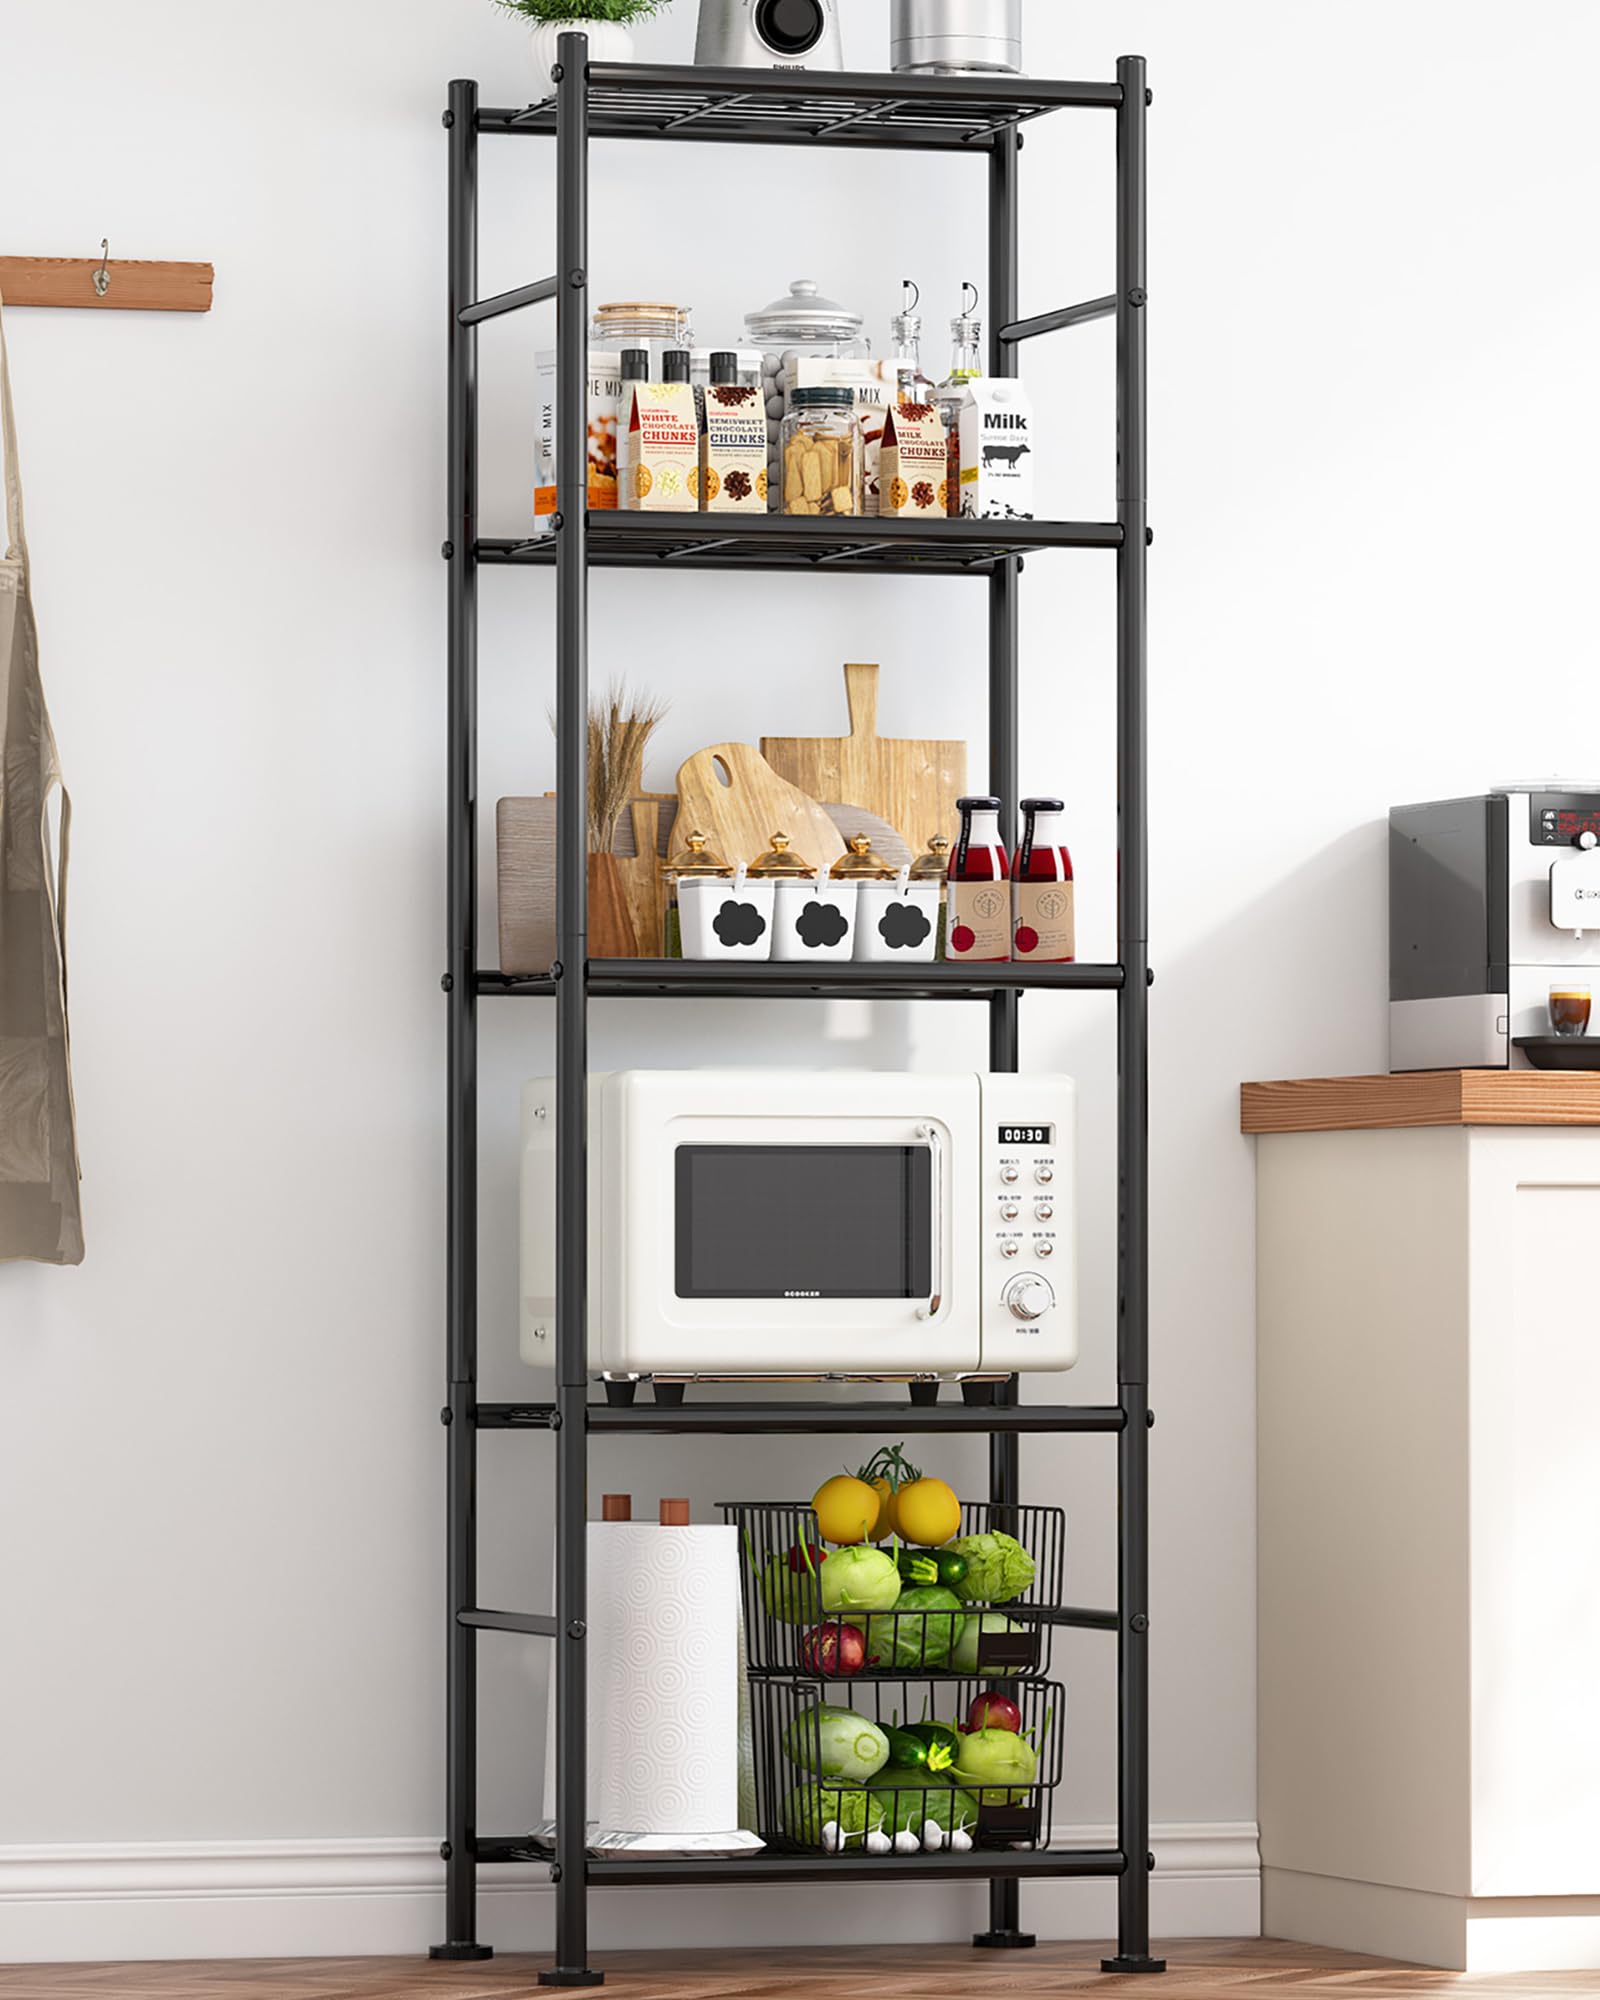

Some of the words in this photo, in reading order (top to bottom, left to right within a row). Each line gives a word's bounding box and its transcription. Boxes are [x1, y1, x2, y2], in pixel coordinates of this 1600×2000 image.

[859, 388, 881, 404] MIX
[542, 404, 552, 429] MIX
[641, 414, 678, 422] WHITE
[984, 413, 1027, 430] Milk
[642, 431, 697, 441] CHUNKS
[710, 433, 765, 443] CHUNKS
[898, 431, 922, 439] MILK
[542, 437, 552, 458] PIE
[899, 439, 944, 447] CHOCOLATE
[900, 446, 945, 457] CHUNKS
[1005, 1129, 1042, 1141] 00:30
